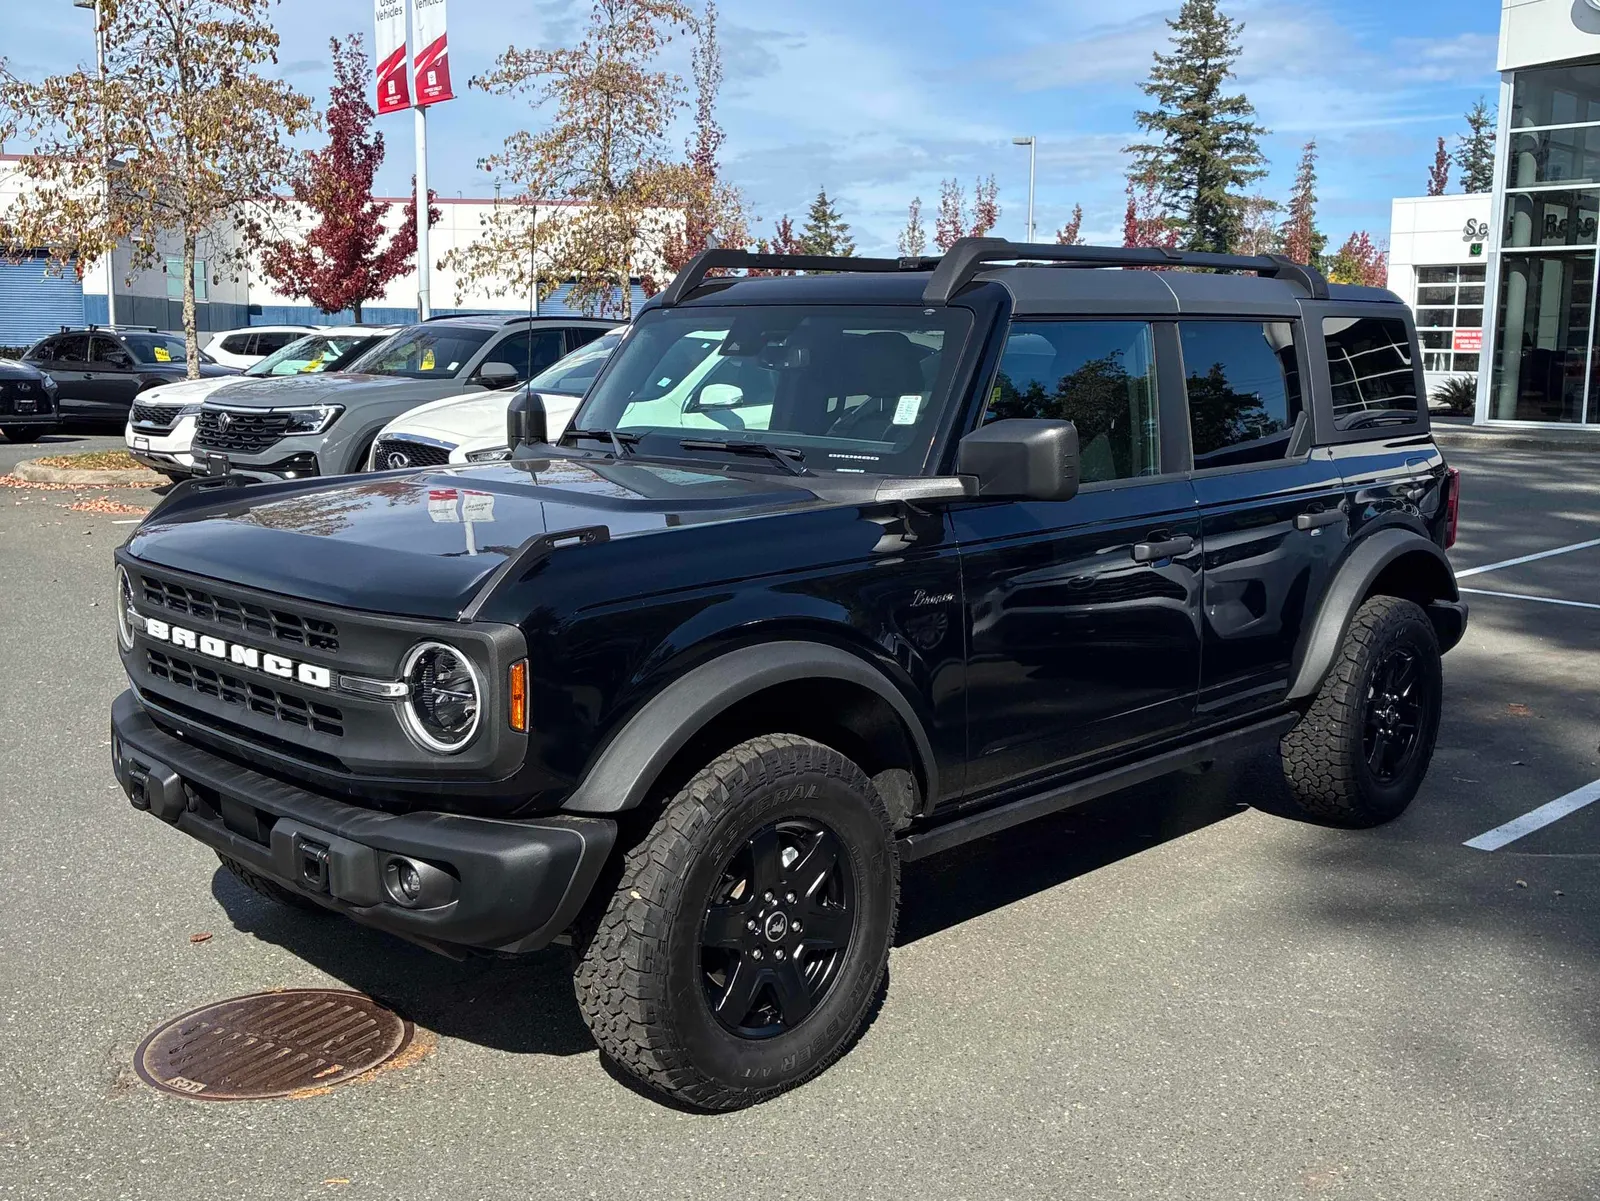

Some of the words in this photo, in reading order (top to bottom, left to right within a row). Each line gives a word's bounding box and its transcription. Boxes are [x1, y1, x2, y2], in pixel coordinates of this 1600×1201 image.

[376, 5, 403, 21] Vehicles
[828, 453, 880, 461] BRONCO
[909, 588, 955, 607] Bronco
[147, 617, 331, 689] BRONCO
